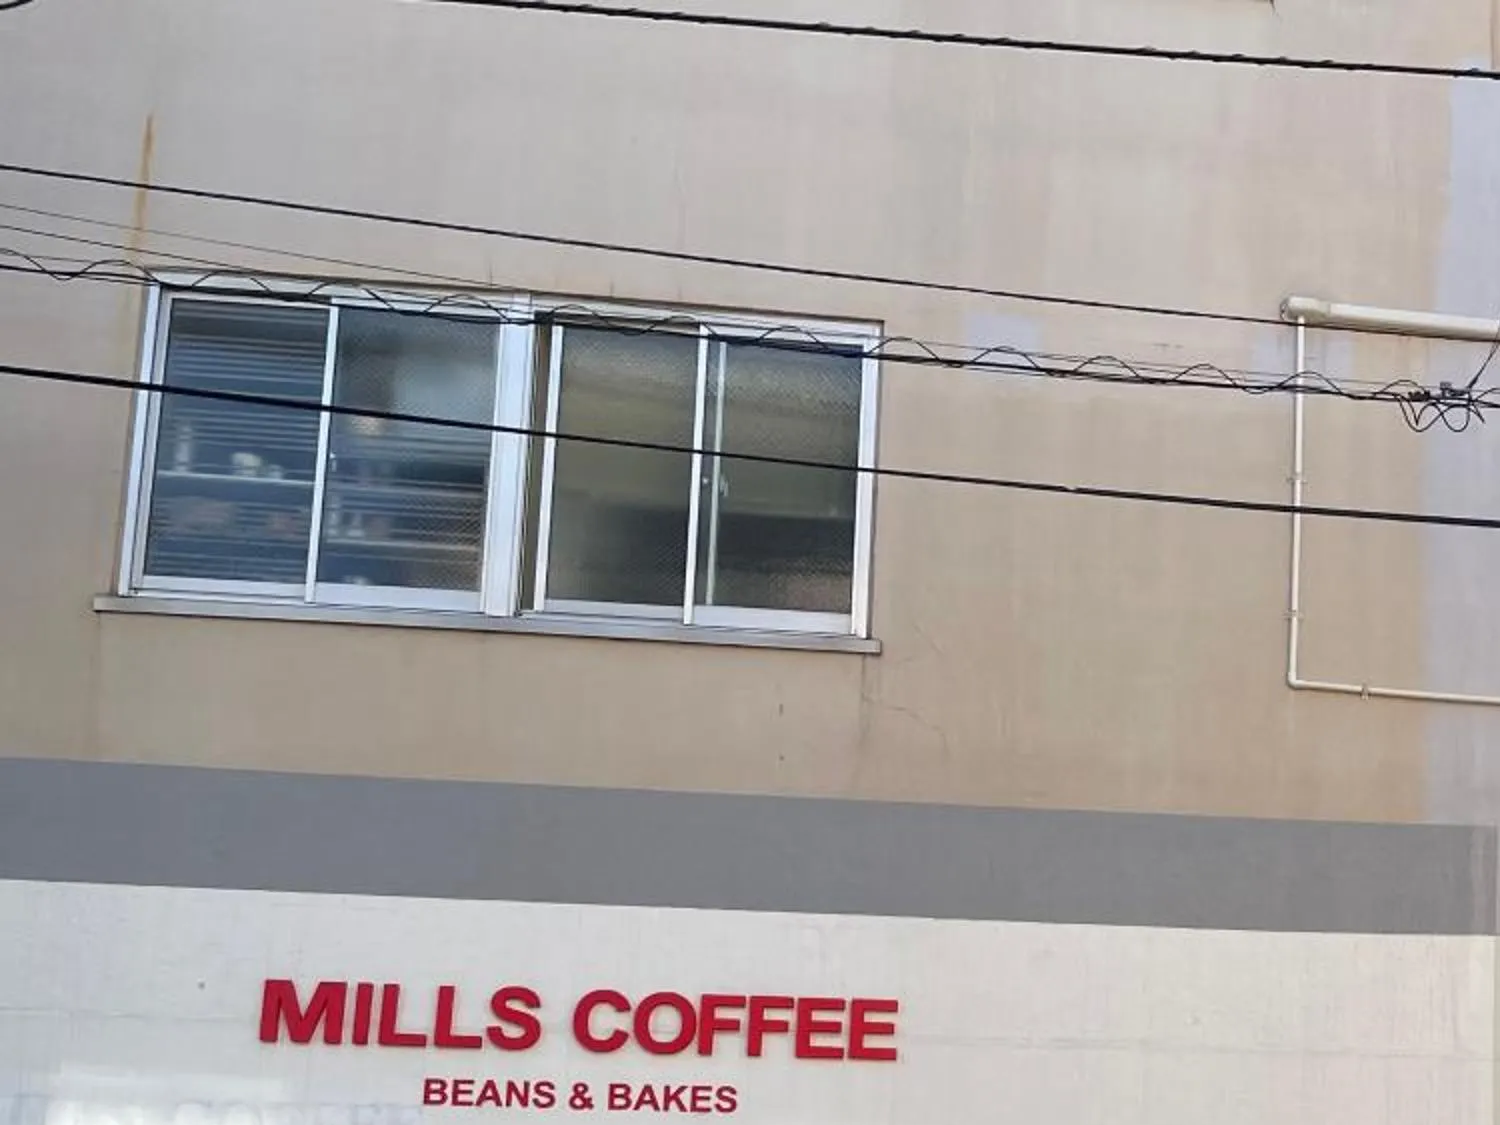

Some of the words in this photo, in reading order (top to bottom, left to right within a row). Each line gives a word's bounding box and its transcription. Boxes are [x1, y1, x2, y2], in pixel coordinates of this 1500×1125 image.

[260, 980, 542, 1050] MILLS
[573, 991, 898, 1061] COFFEE
[422, 1079, 555, 1109] BEANS
[571, 1084, 595, 1110] &
[608, 1084, 739, 1113] BAKES
